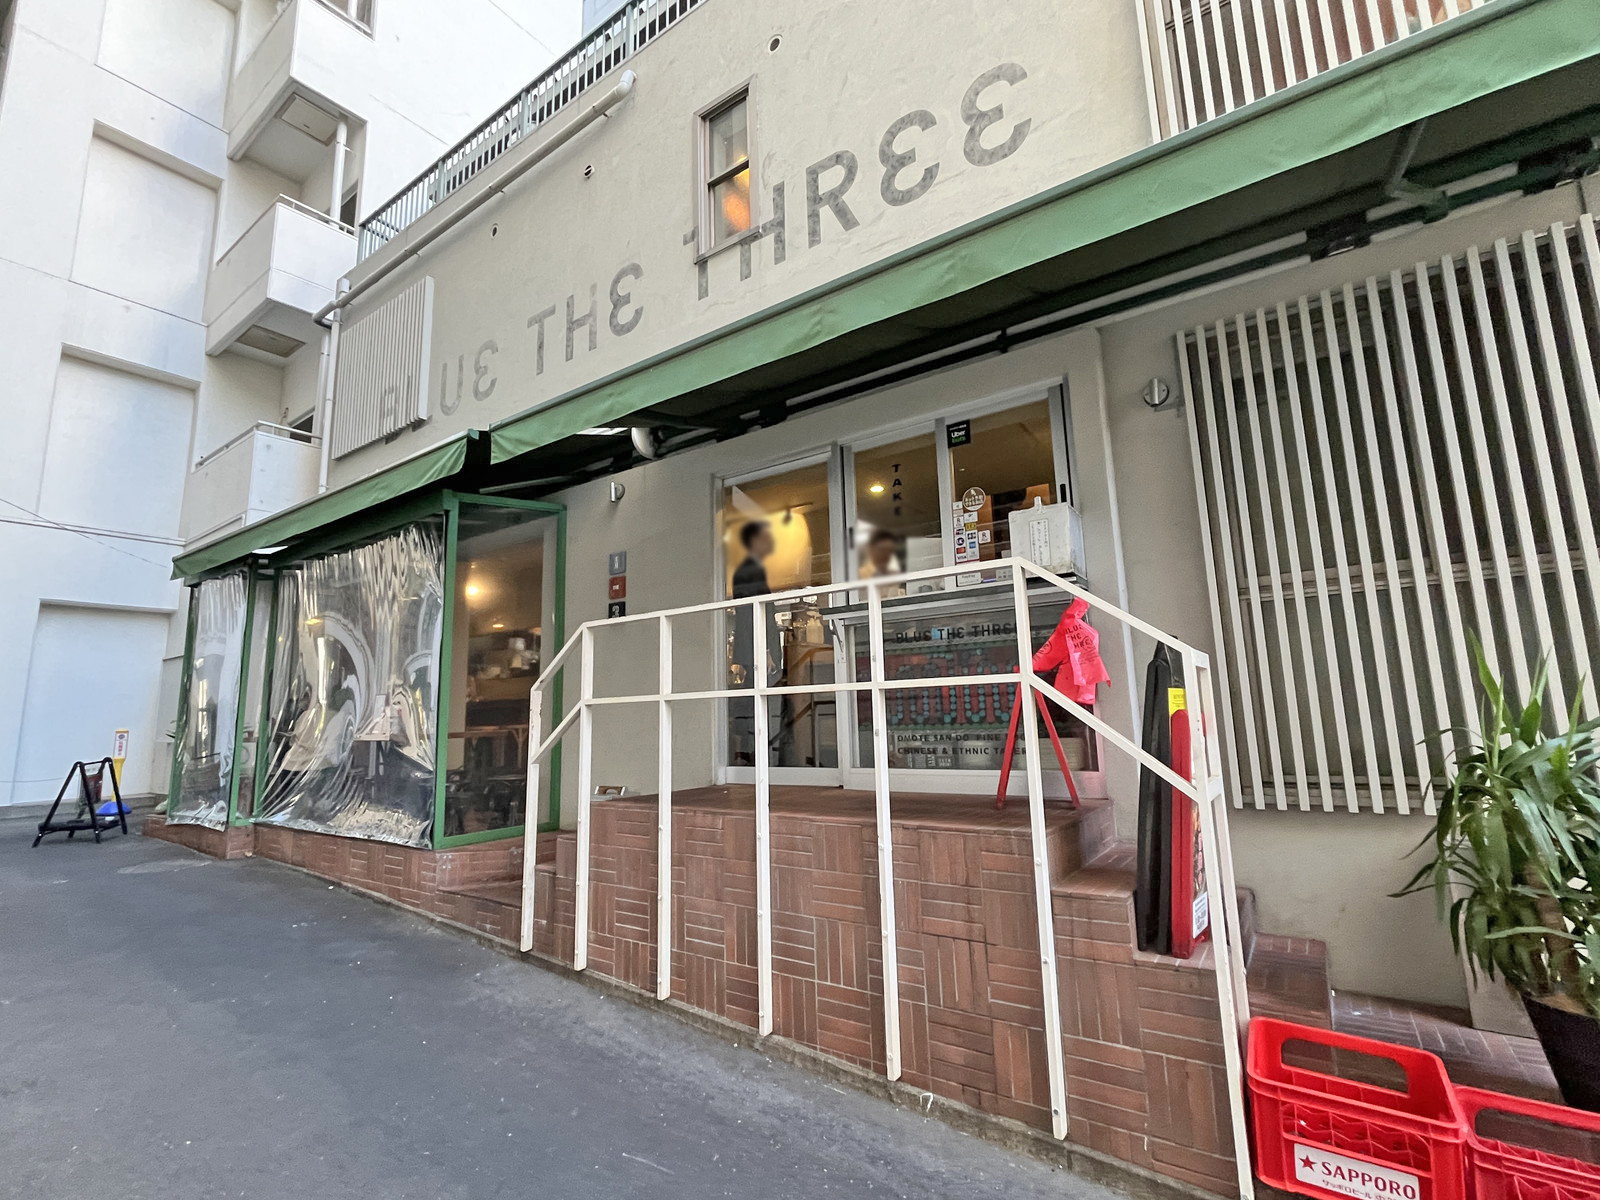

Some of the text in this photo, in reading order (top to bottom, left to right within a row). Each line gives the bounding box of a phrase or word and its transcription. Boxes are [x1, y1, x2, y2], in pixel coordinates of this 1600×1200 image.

[527, 262, 644, 376] THE
[951, 430, 966, 438] Uber
[937, 626, 965, 640] THE
[971, 621, 1017, 637] THRE
[897, 747, 938, 755] CHINESE
[952, 747, 989, 755] ETHNIC
[1321, 1161, 1416, 1200] SAPPORO
